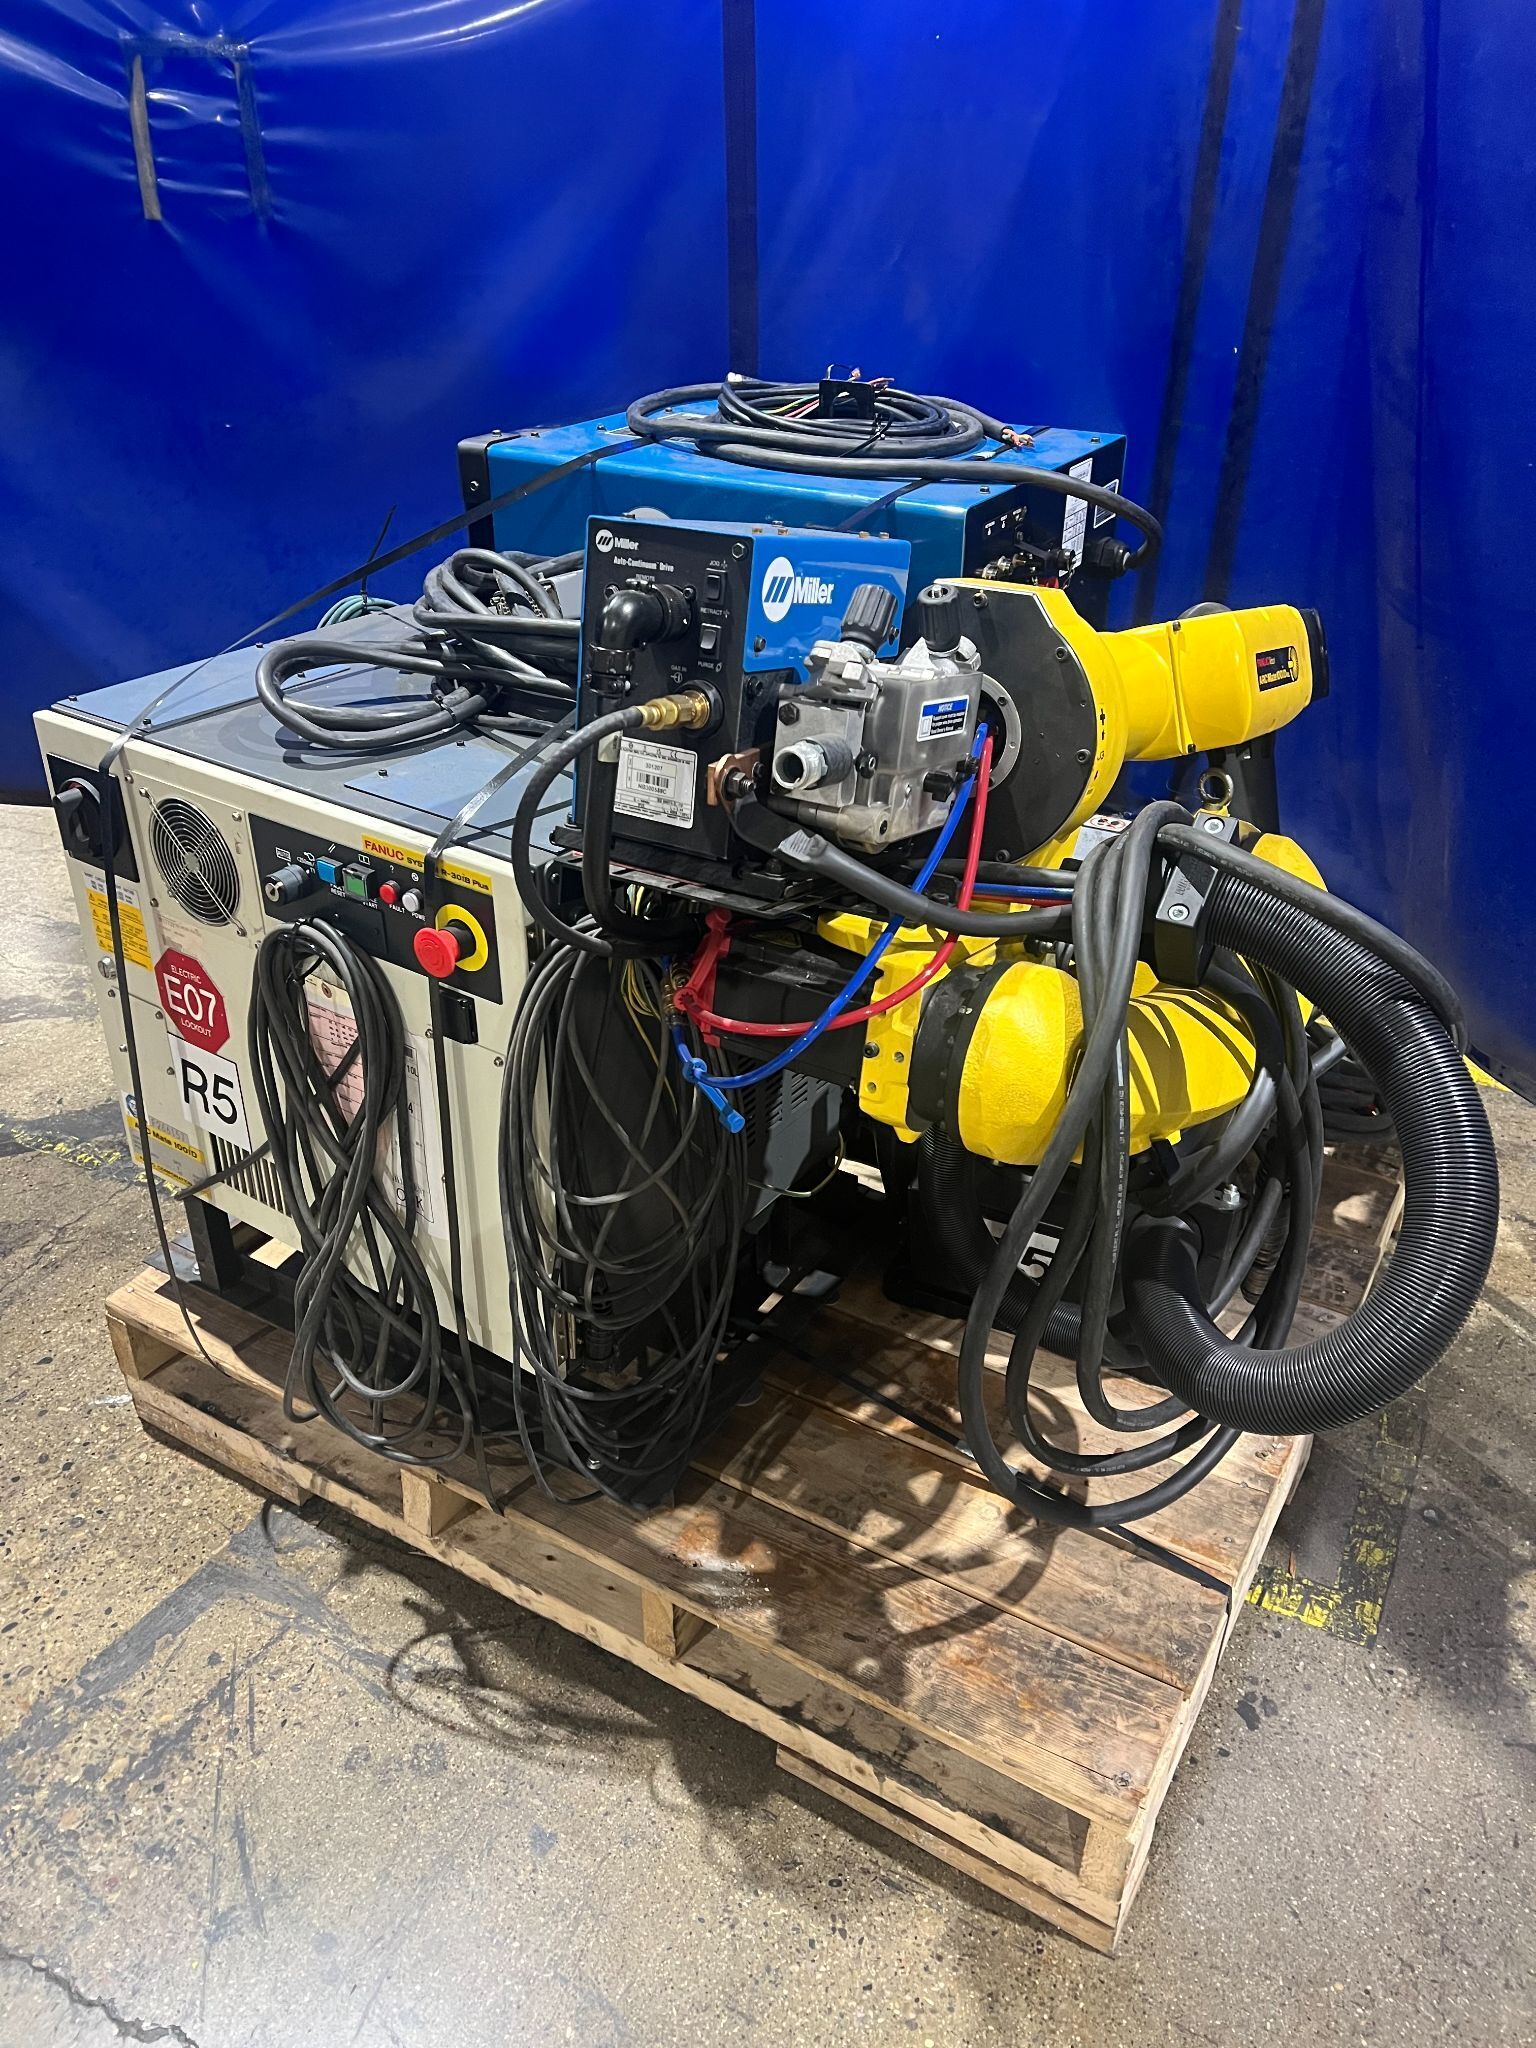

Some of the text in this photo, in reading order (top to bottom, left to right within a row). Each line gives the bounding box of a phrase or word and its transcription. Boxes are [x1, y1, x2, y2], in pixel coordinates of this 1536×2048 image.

[614, 536, 639, 550] Miller
[659, 561, 674, 572] Drive
[792, 576, 835, 604] Miller
[700, 607, 723, 616] RETRACT
[698, 661, 714, 670] PURGE
[364, 839, 404, 861] FANUC
[440, 868, 471, 885] R-30iB
[472, 879, 490, 891] Plus
[330, 887, 346, 898] RESET
[389, 903, 405, 914] FAULT
[171, 964, 202, 985] ELECTRIC
[163, 972, 216, 1028] E07
[181, 1017, 212, 1037] LOCKOUT
[181, 1057, 238, 1125] R5
[152, 1130, 172, 1146] Mate
